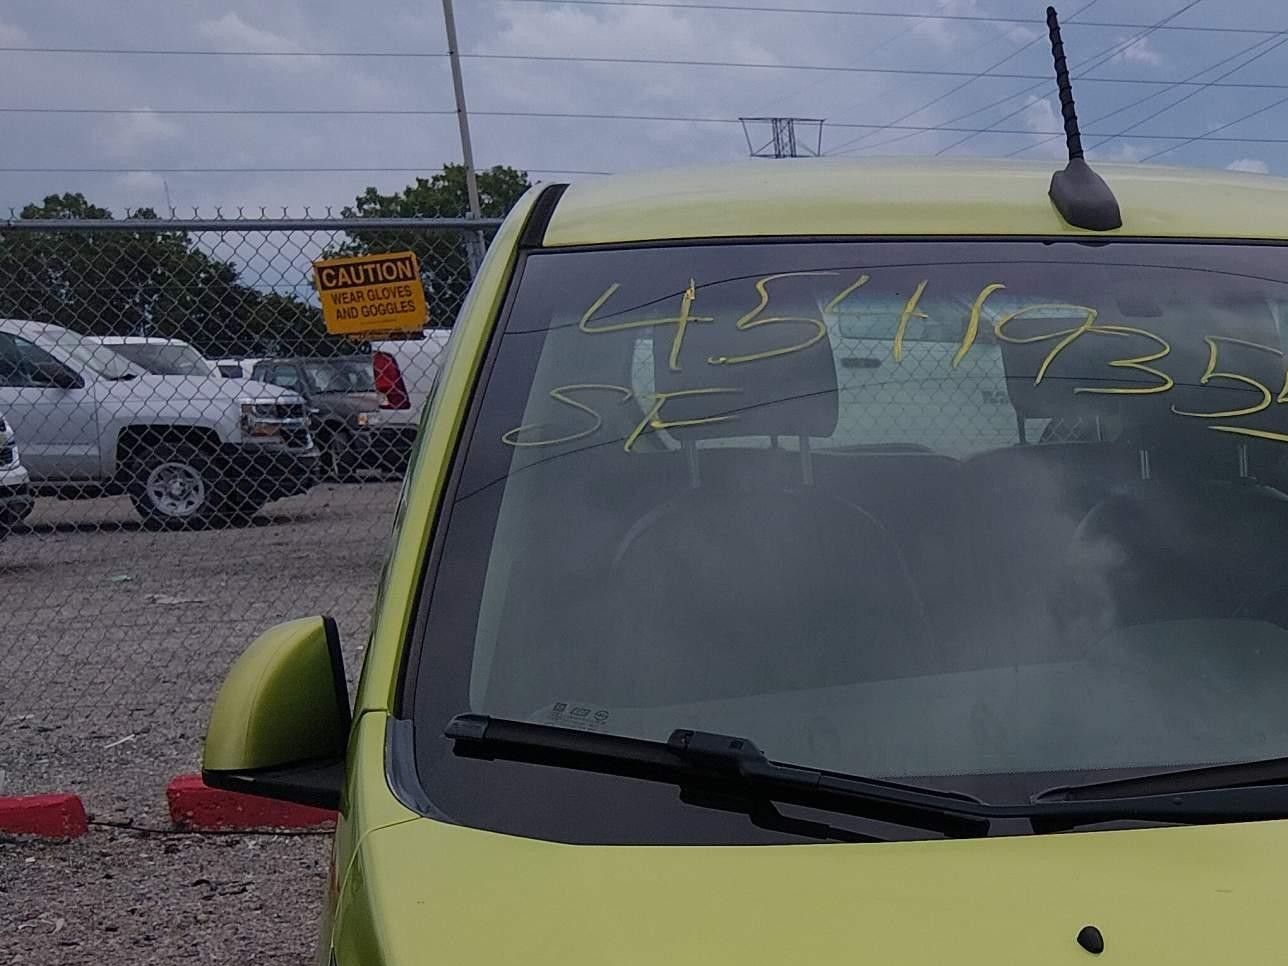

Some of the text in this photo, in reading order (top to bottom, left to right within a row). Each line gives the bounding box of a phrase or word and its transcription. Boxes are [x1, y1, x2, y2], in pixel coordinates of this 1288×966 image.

[322, 261, 412, 287] CAUTION
[330, 285, 412, 305] WEAR GLOVES
[336, 301, 416, 320] AND GOGGLES
